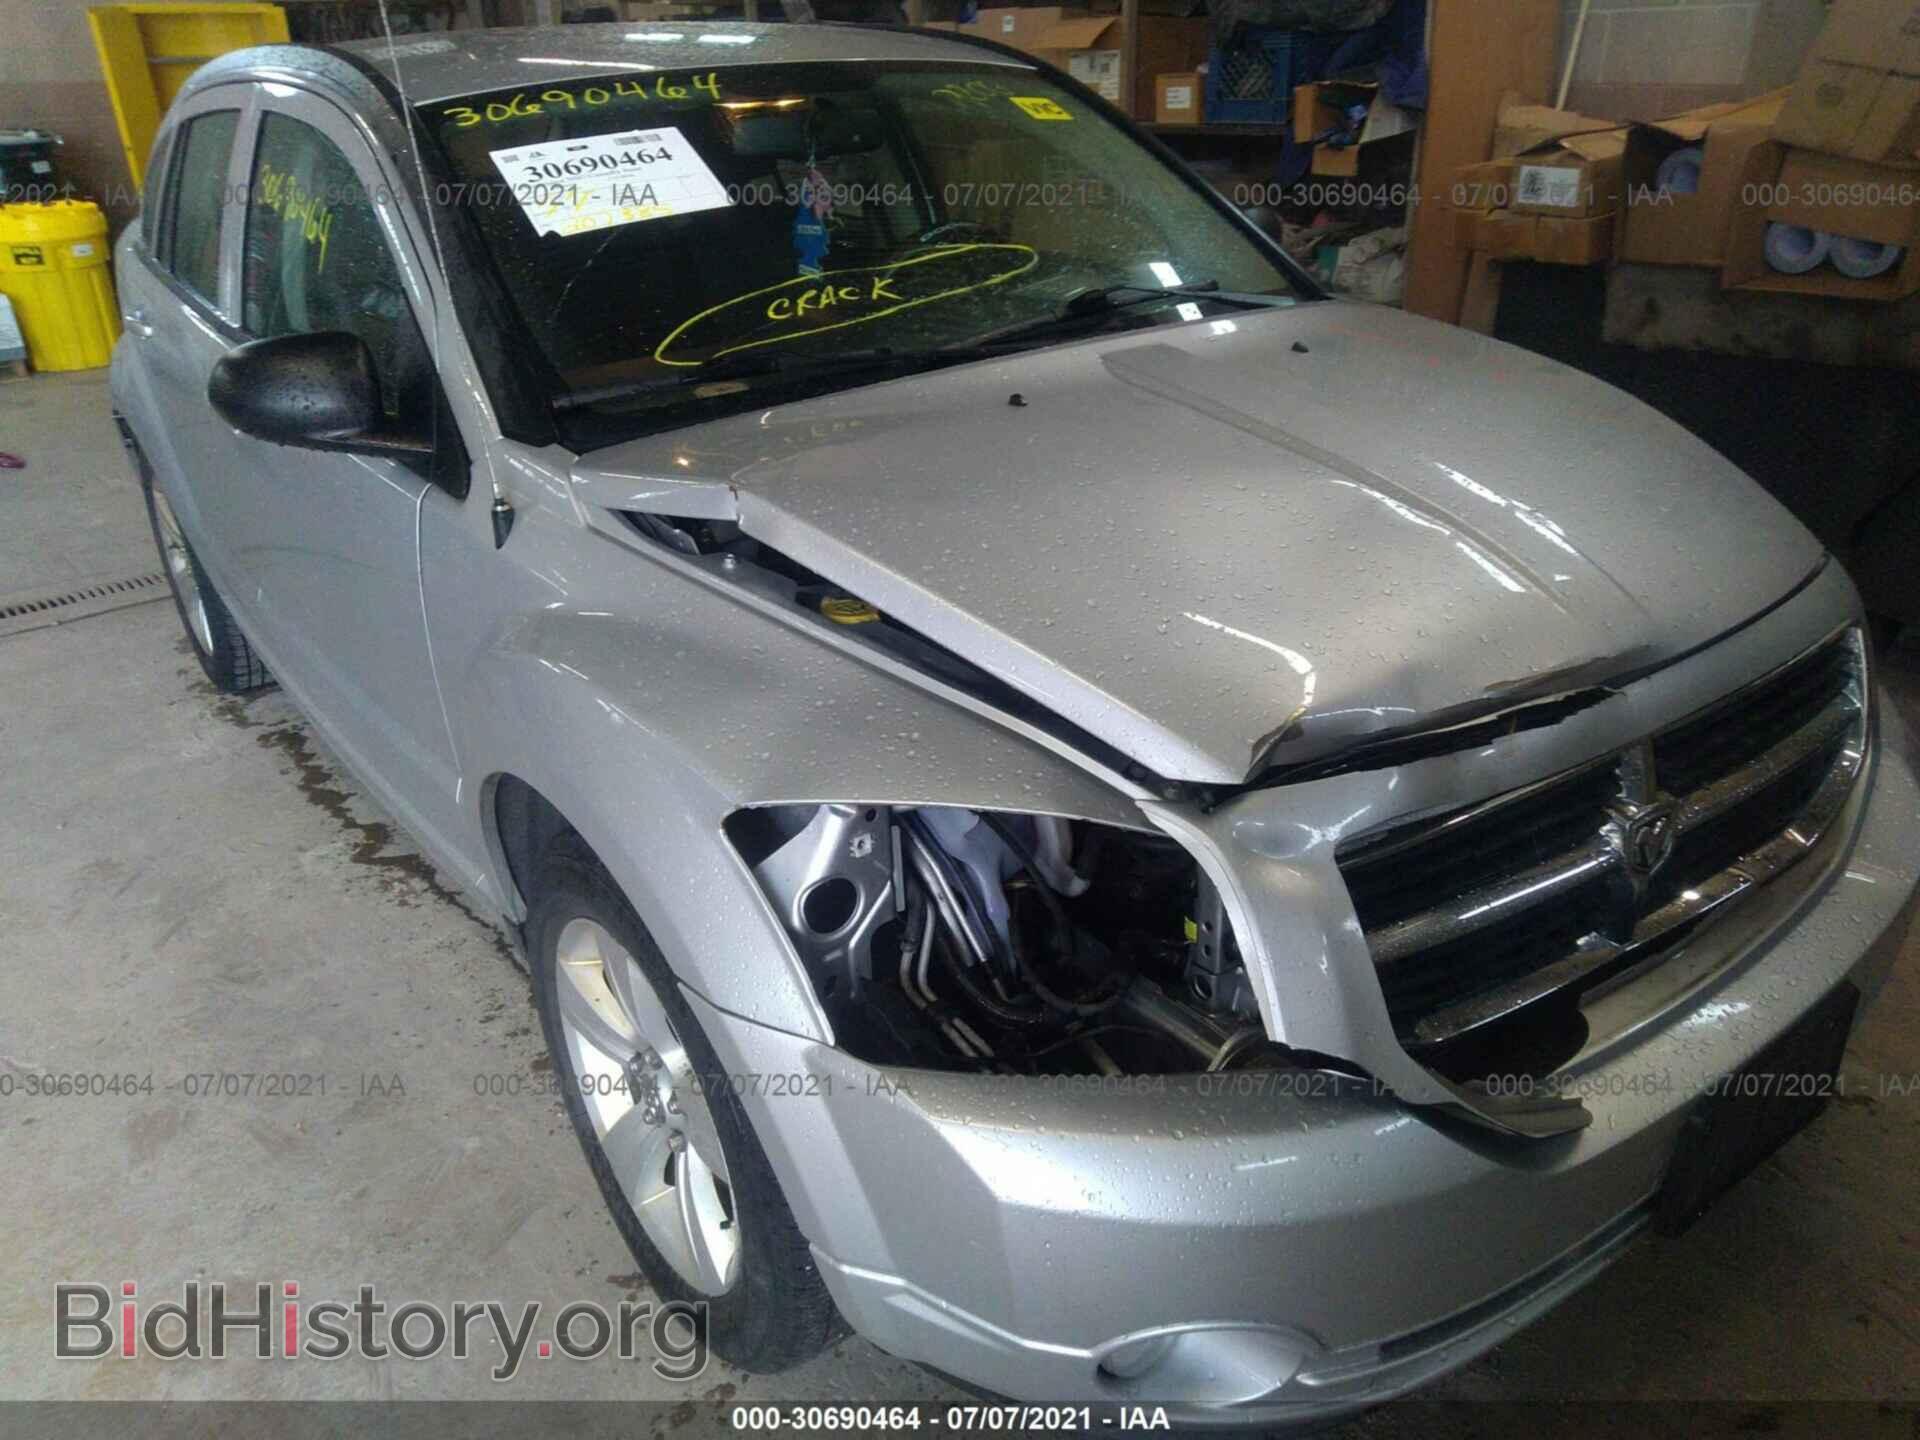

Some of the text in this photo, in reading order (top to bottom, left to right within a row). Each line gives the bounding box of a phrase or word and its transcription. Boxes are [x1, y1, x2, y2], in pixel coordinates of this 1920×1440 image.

[443, 72, 721, 127] 30690464
[523, 146, 673, 184] 30690464
[766, 276, 902, 320] CRACK
